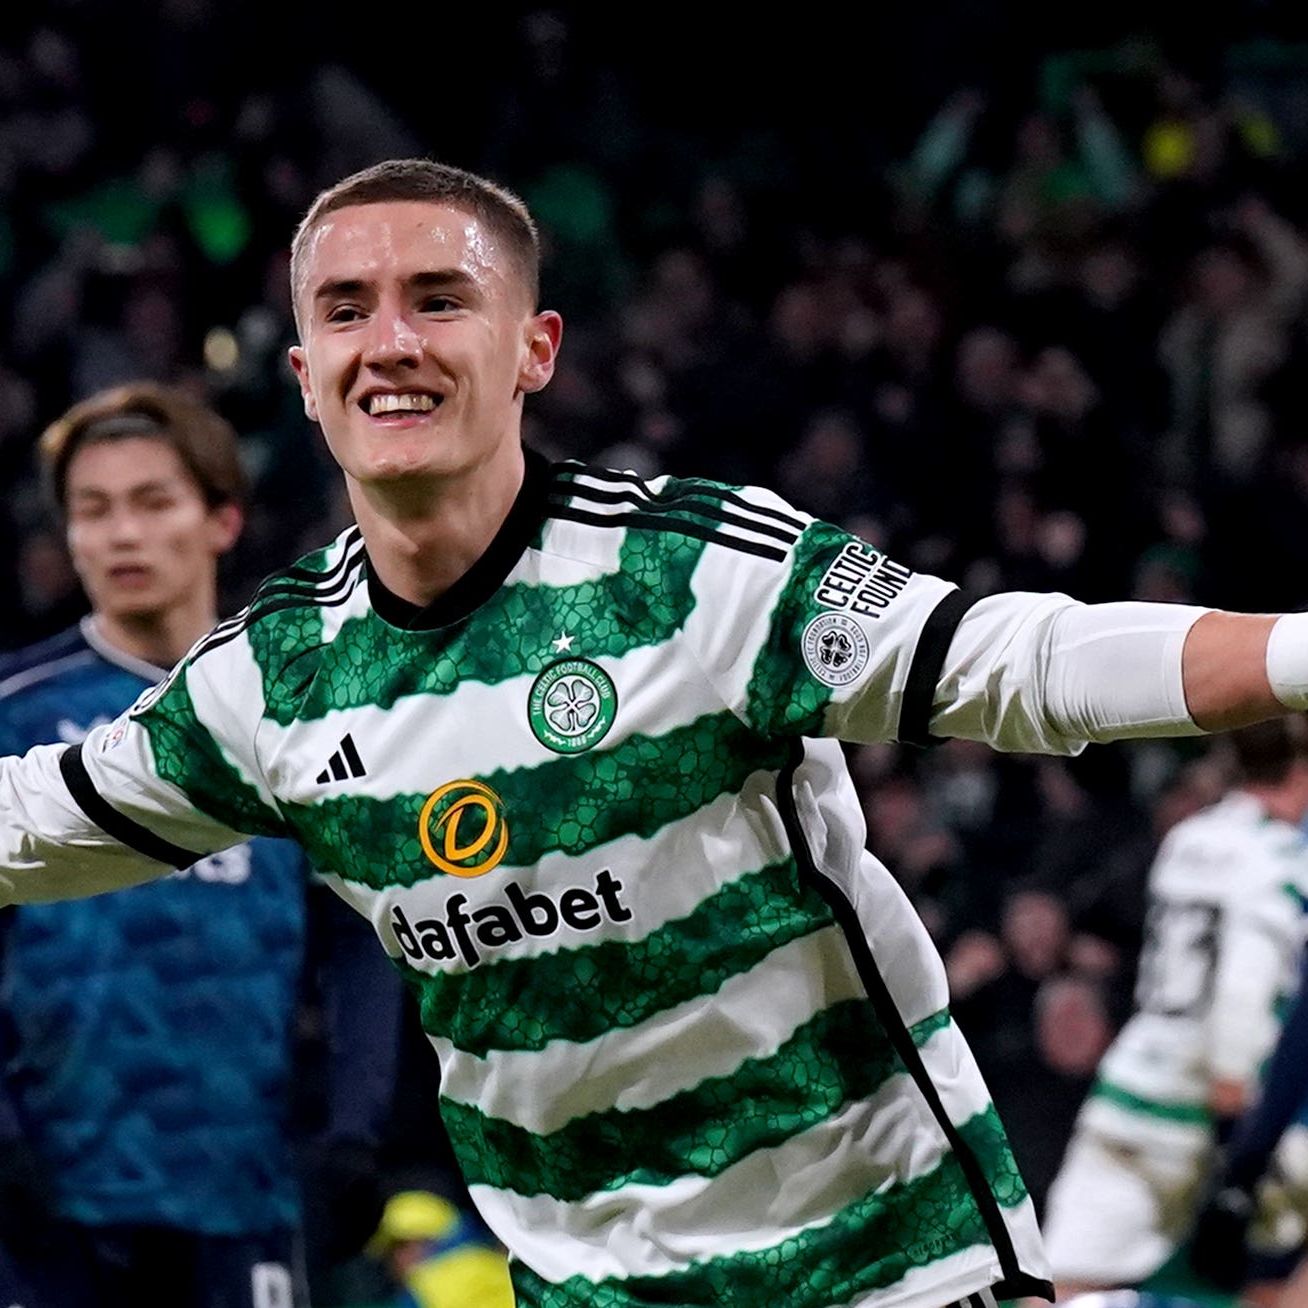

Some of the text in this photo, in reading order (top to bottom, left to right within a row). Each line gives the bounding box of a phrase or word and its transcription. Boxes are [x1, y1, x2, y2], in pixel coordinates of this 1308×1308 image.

[817, 544, 879, 608] CELTIC
[535, 671, 557, 697] CELTIC
[555, 662, 595, 680] FOOTBALL
[595, 675, 611, 699] CLUB
[392, 869, 633, 968] dafabet
